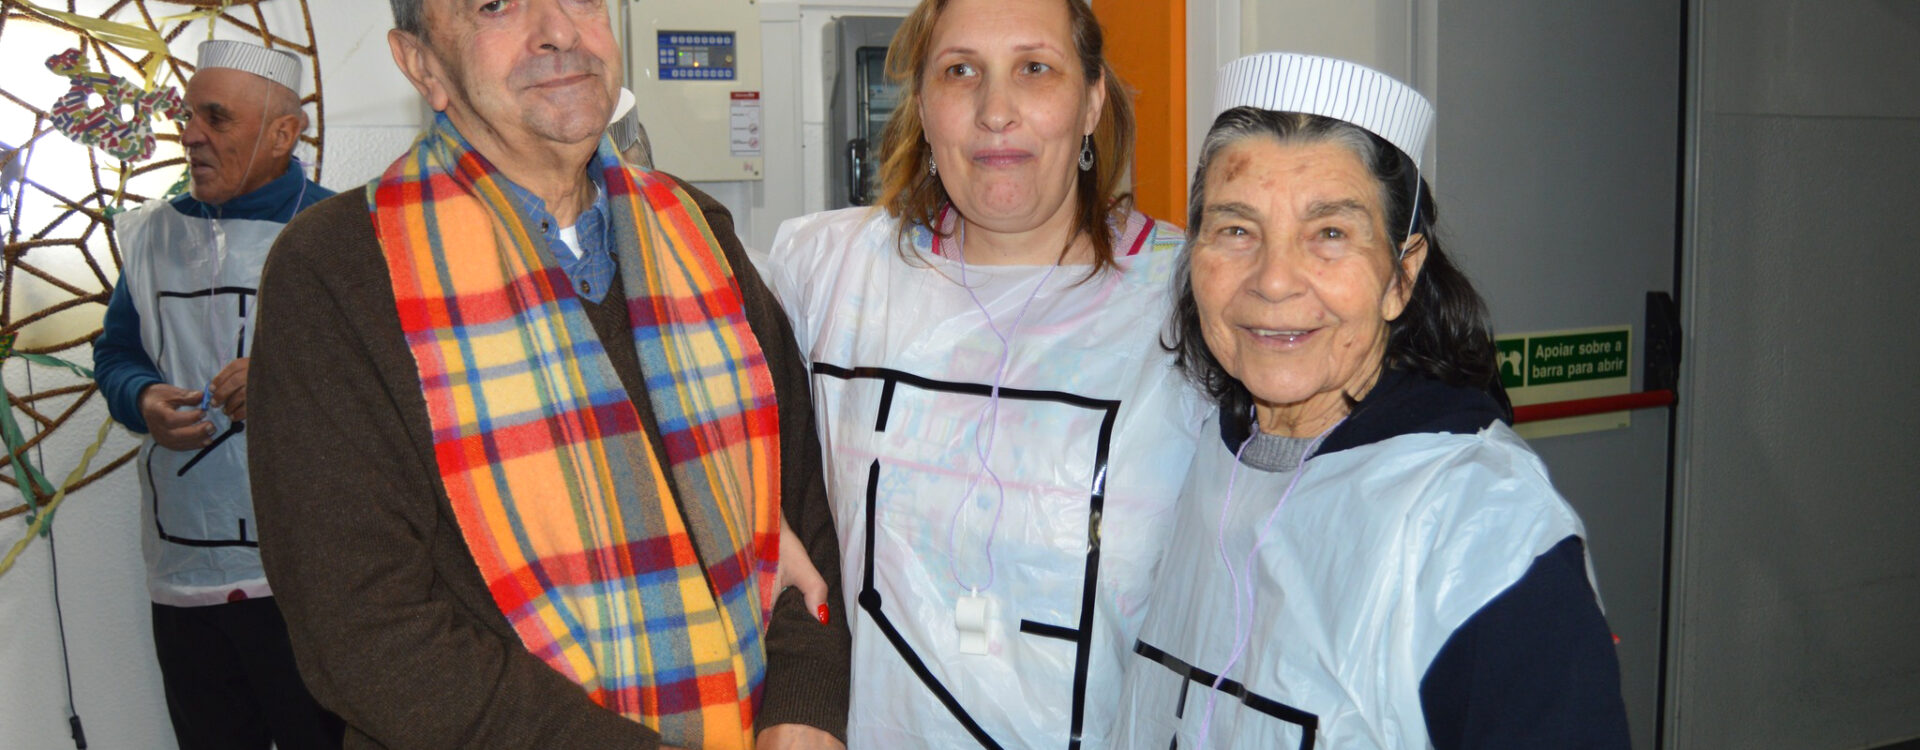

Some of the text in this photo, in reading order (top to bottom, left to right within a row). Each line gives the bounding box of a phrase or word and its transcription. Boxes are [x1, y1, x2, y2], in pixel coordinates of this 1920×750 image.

[1535, 340, 1622, 361] Apoiar sobre a
[1532, 358, 1624, 379] barra para abrir
